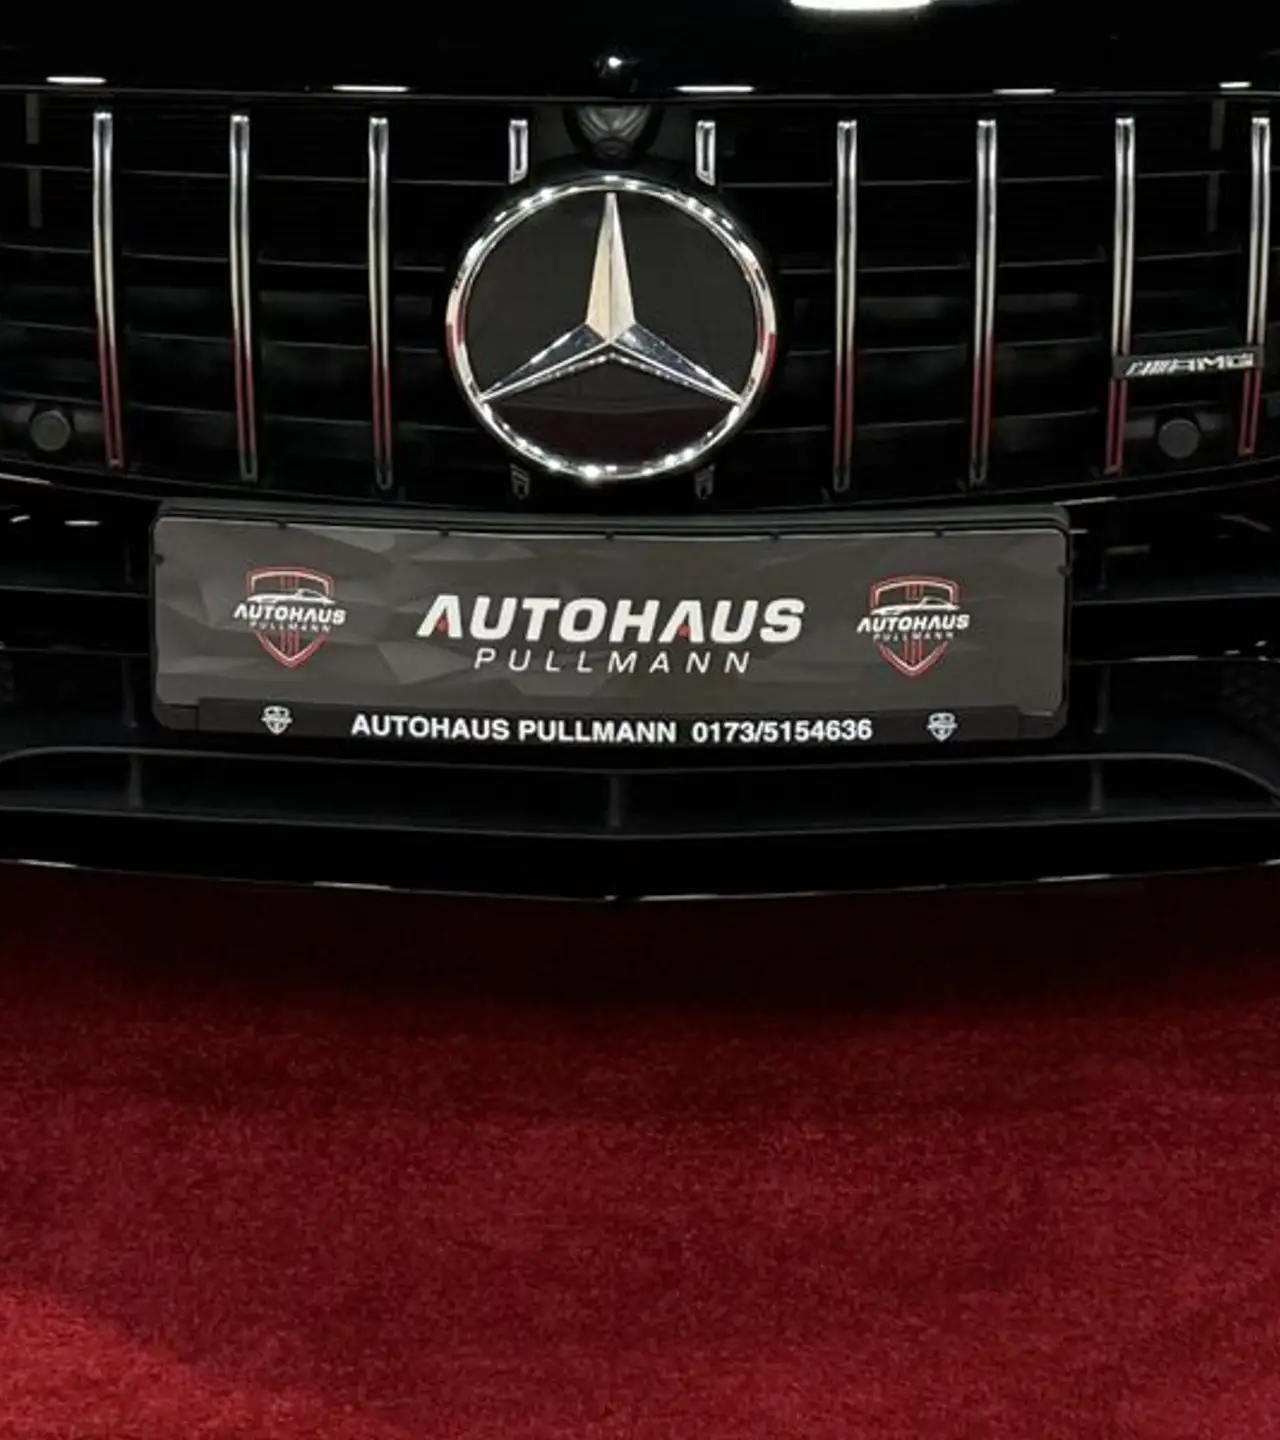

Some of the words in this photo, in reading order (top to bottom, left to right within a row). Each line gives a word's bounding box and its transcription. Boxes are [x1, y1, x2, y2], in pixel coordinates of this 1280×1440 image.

[232, 602, 348, 625] AUTOHAUS
[417, 594, 806, 644] AUTOHAUS
[856, 614, 971, 634] AUTOHAUS
[474, 647, 751, 675] PULLMANN
[351, 713, 511, 741] AUTOHAUS
[518, 719, 678, 743] PULLMANN
[691, 718, 873, 743] 0173/5154636
